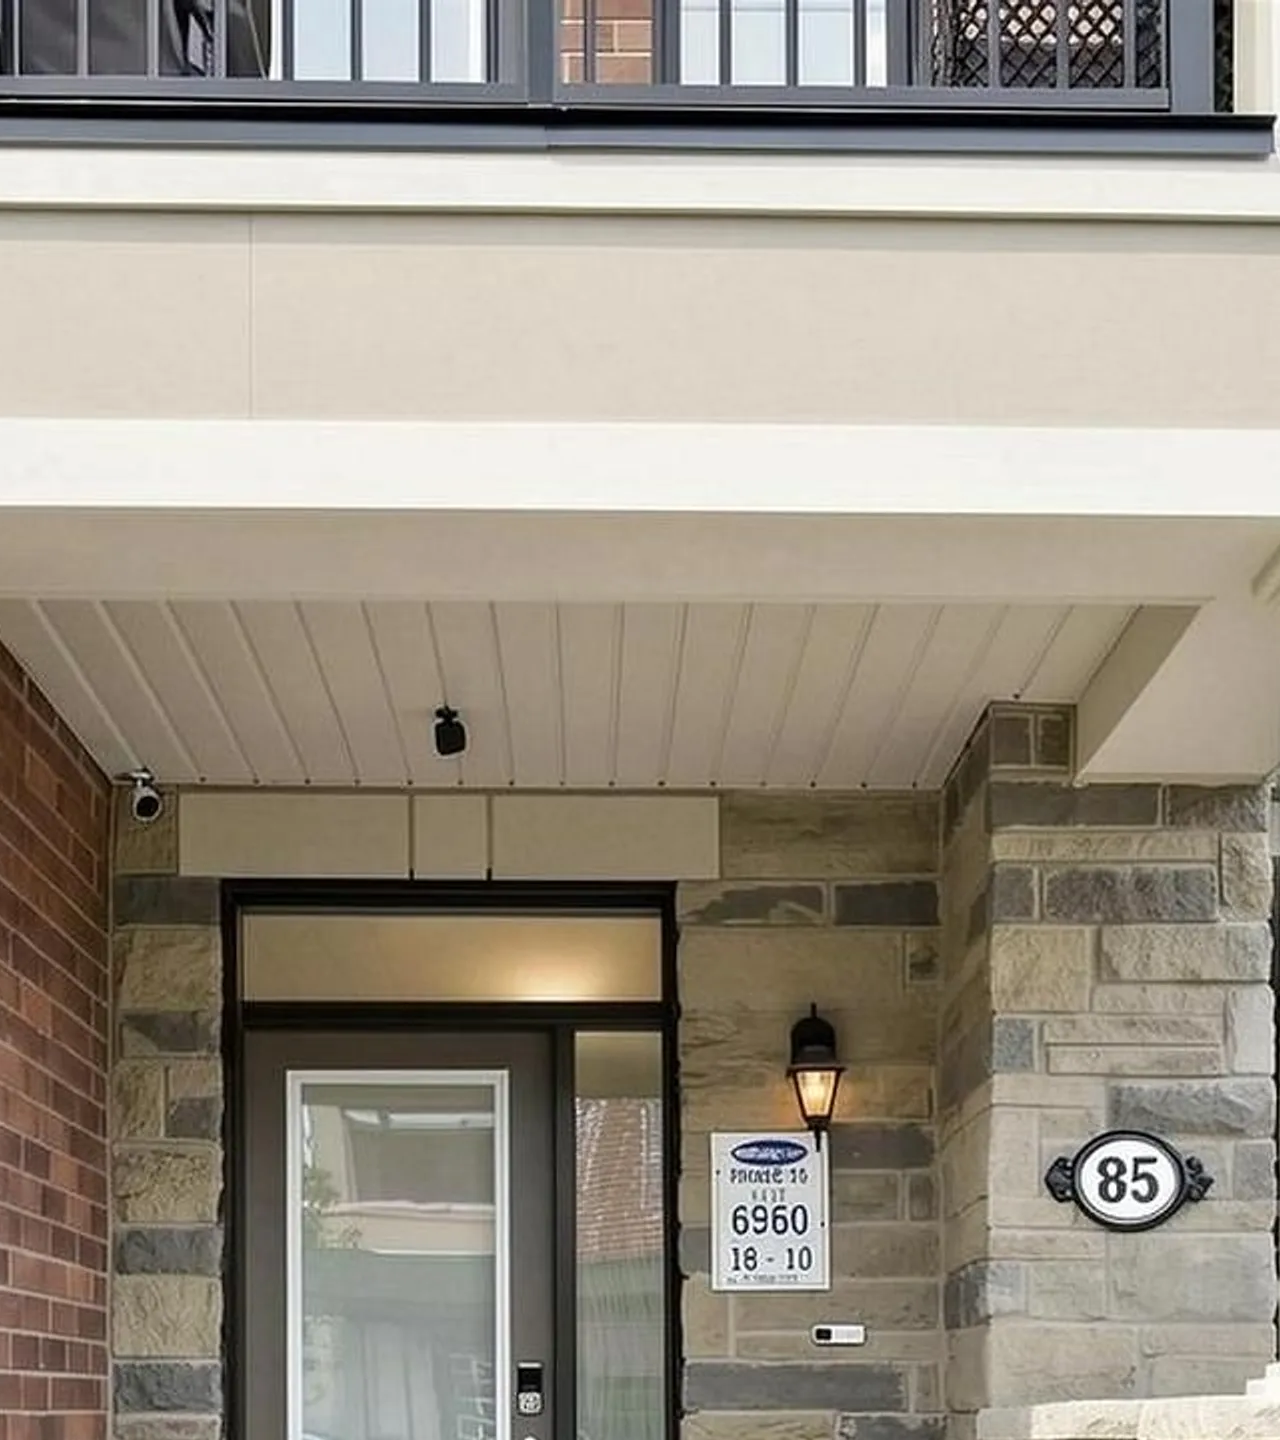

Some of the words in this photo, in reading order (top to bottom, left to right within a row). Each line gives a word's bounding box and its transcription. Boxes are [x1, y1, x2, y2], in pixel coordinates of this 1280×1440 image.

[1097, 1156, 1159, 1203] 85
[731, 1204, 809, 1236] 6960
[730, 1246, 758, 1271] 18
[786, 1246, 813, 1271] 10
